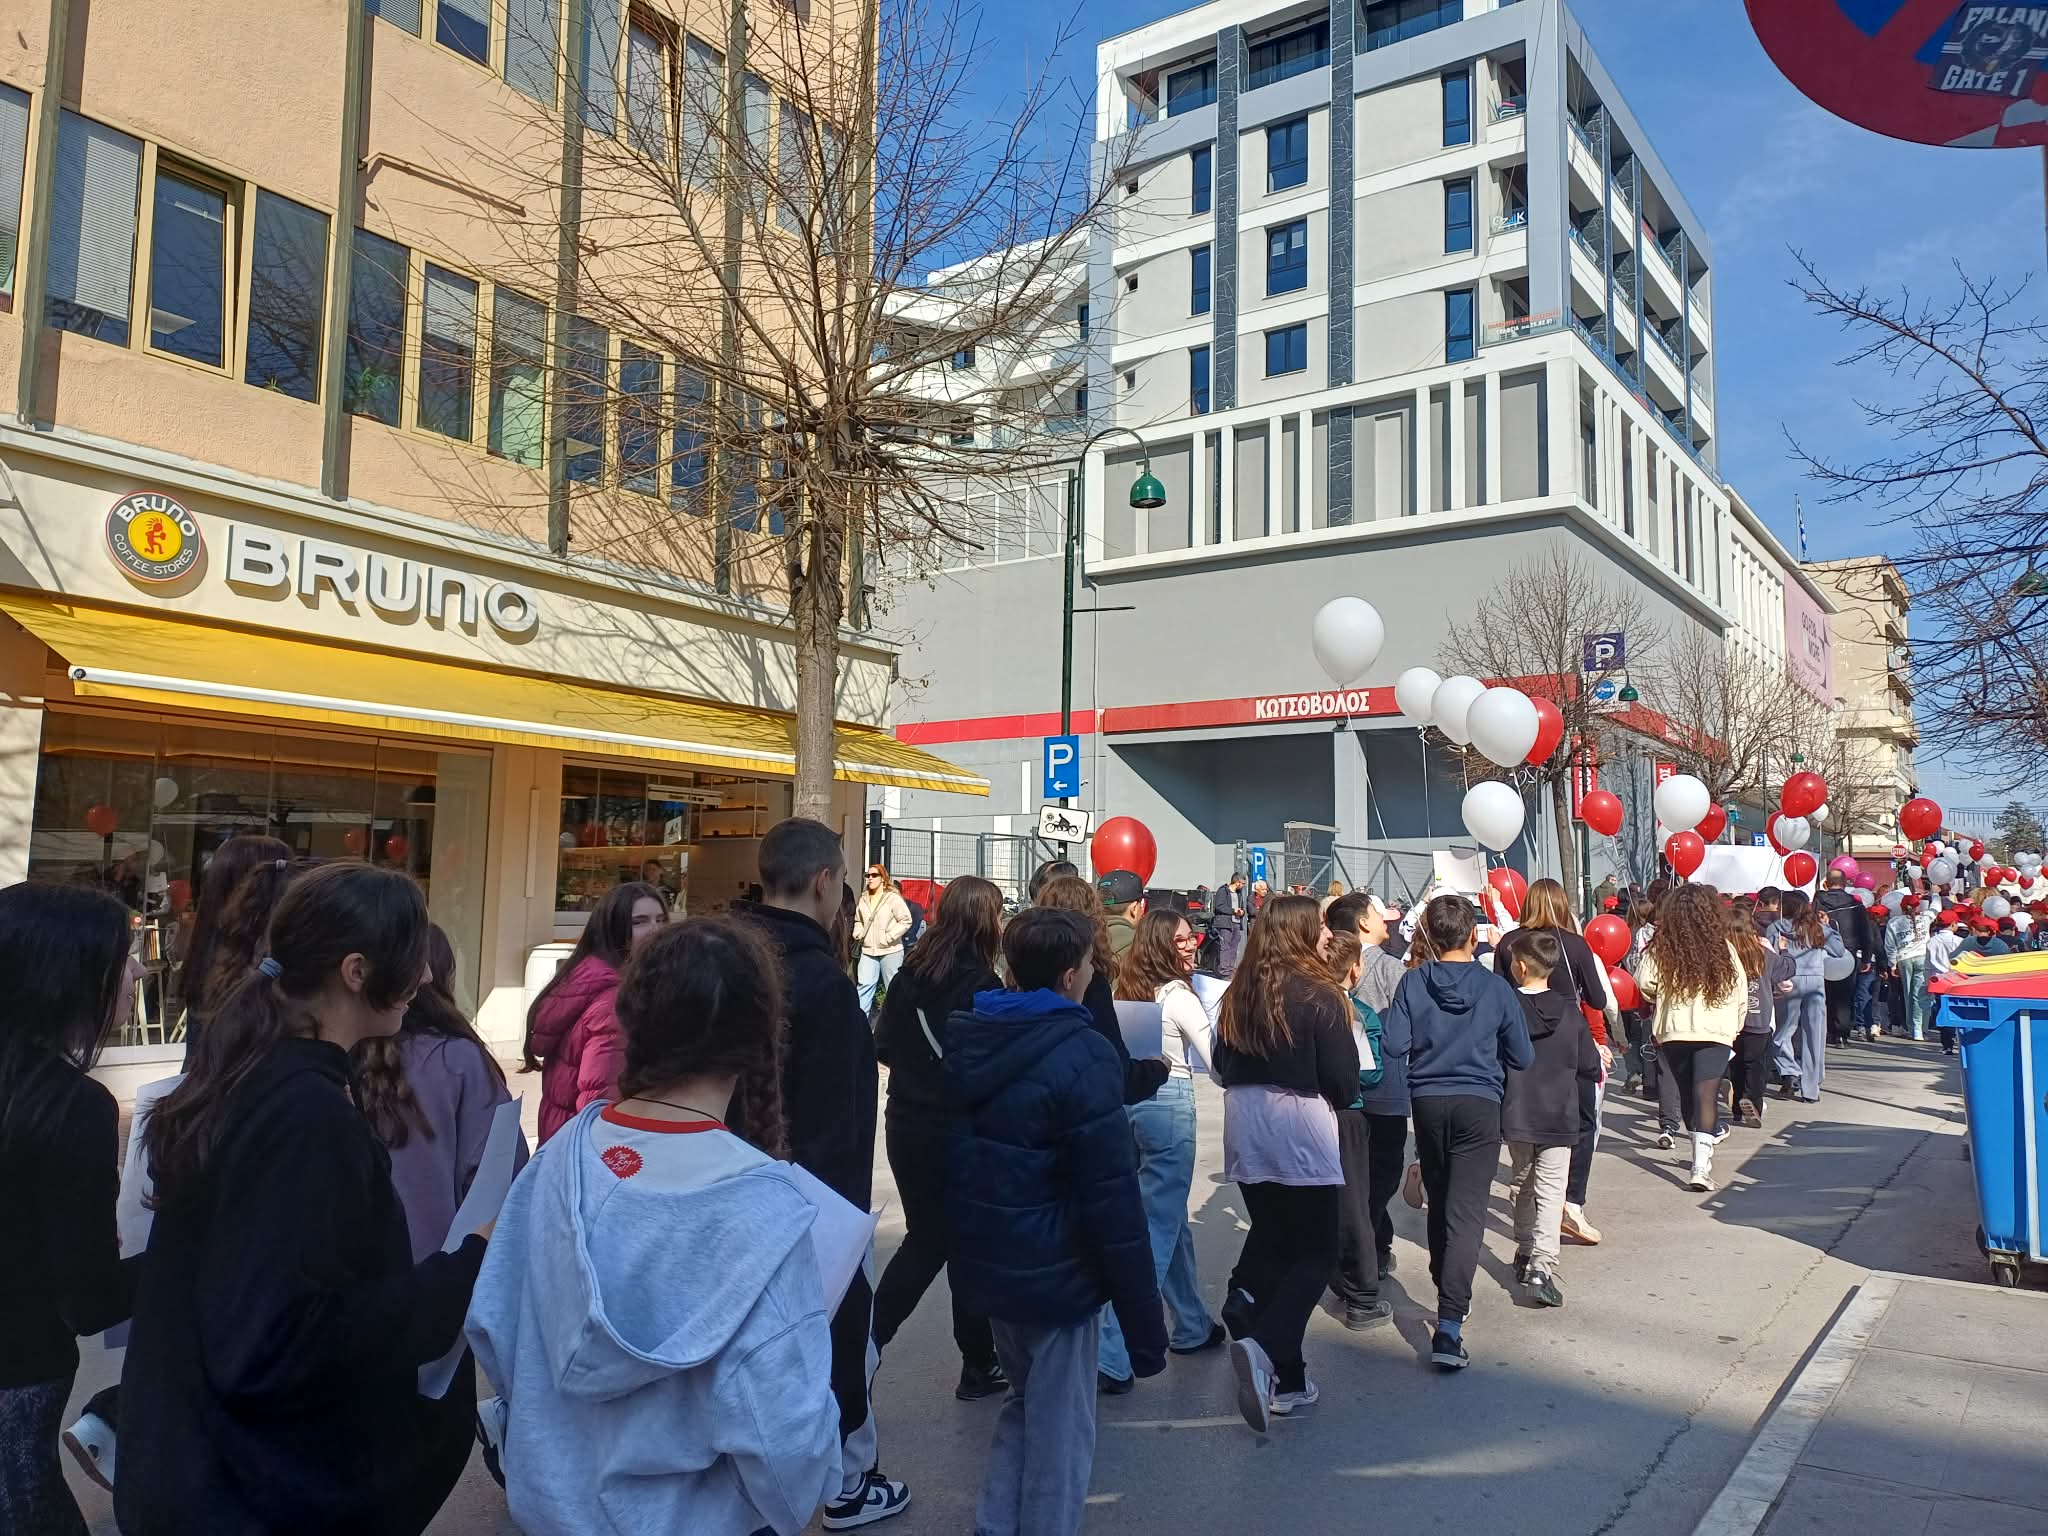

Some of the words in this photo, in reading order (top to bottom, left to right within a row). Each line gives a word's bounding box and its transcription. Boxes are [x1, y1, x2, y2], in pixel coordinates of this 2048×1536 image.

[1941, 65, 2008, 91] GATE
[2009, 69, 2028, 96] 1
[115, 533, 150, 573] COFFEE
[153, 548, 193, 575] STORES
[1255, 690, 1370, 719] ΚΩΤΣΟΒΟΛΟΣ
[1048, 743, 1074, 779] P
[1254, 852, 1264, 873] P
